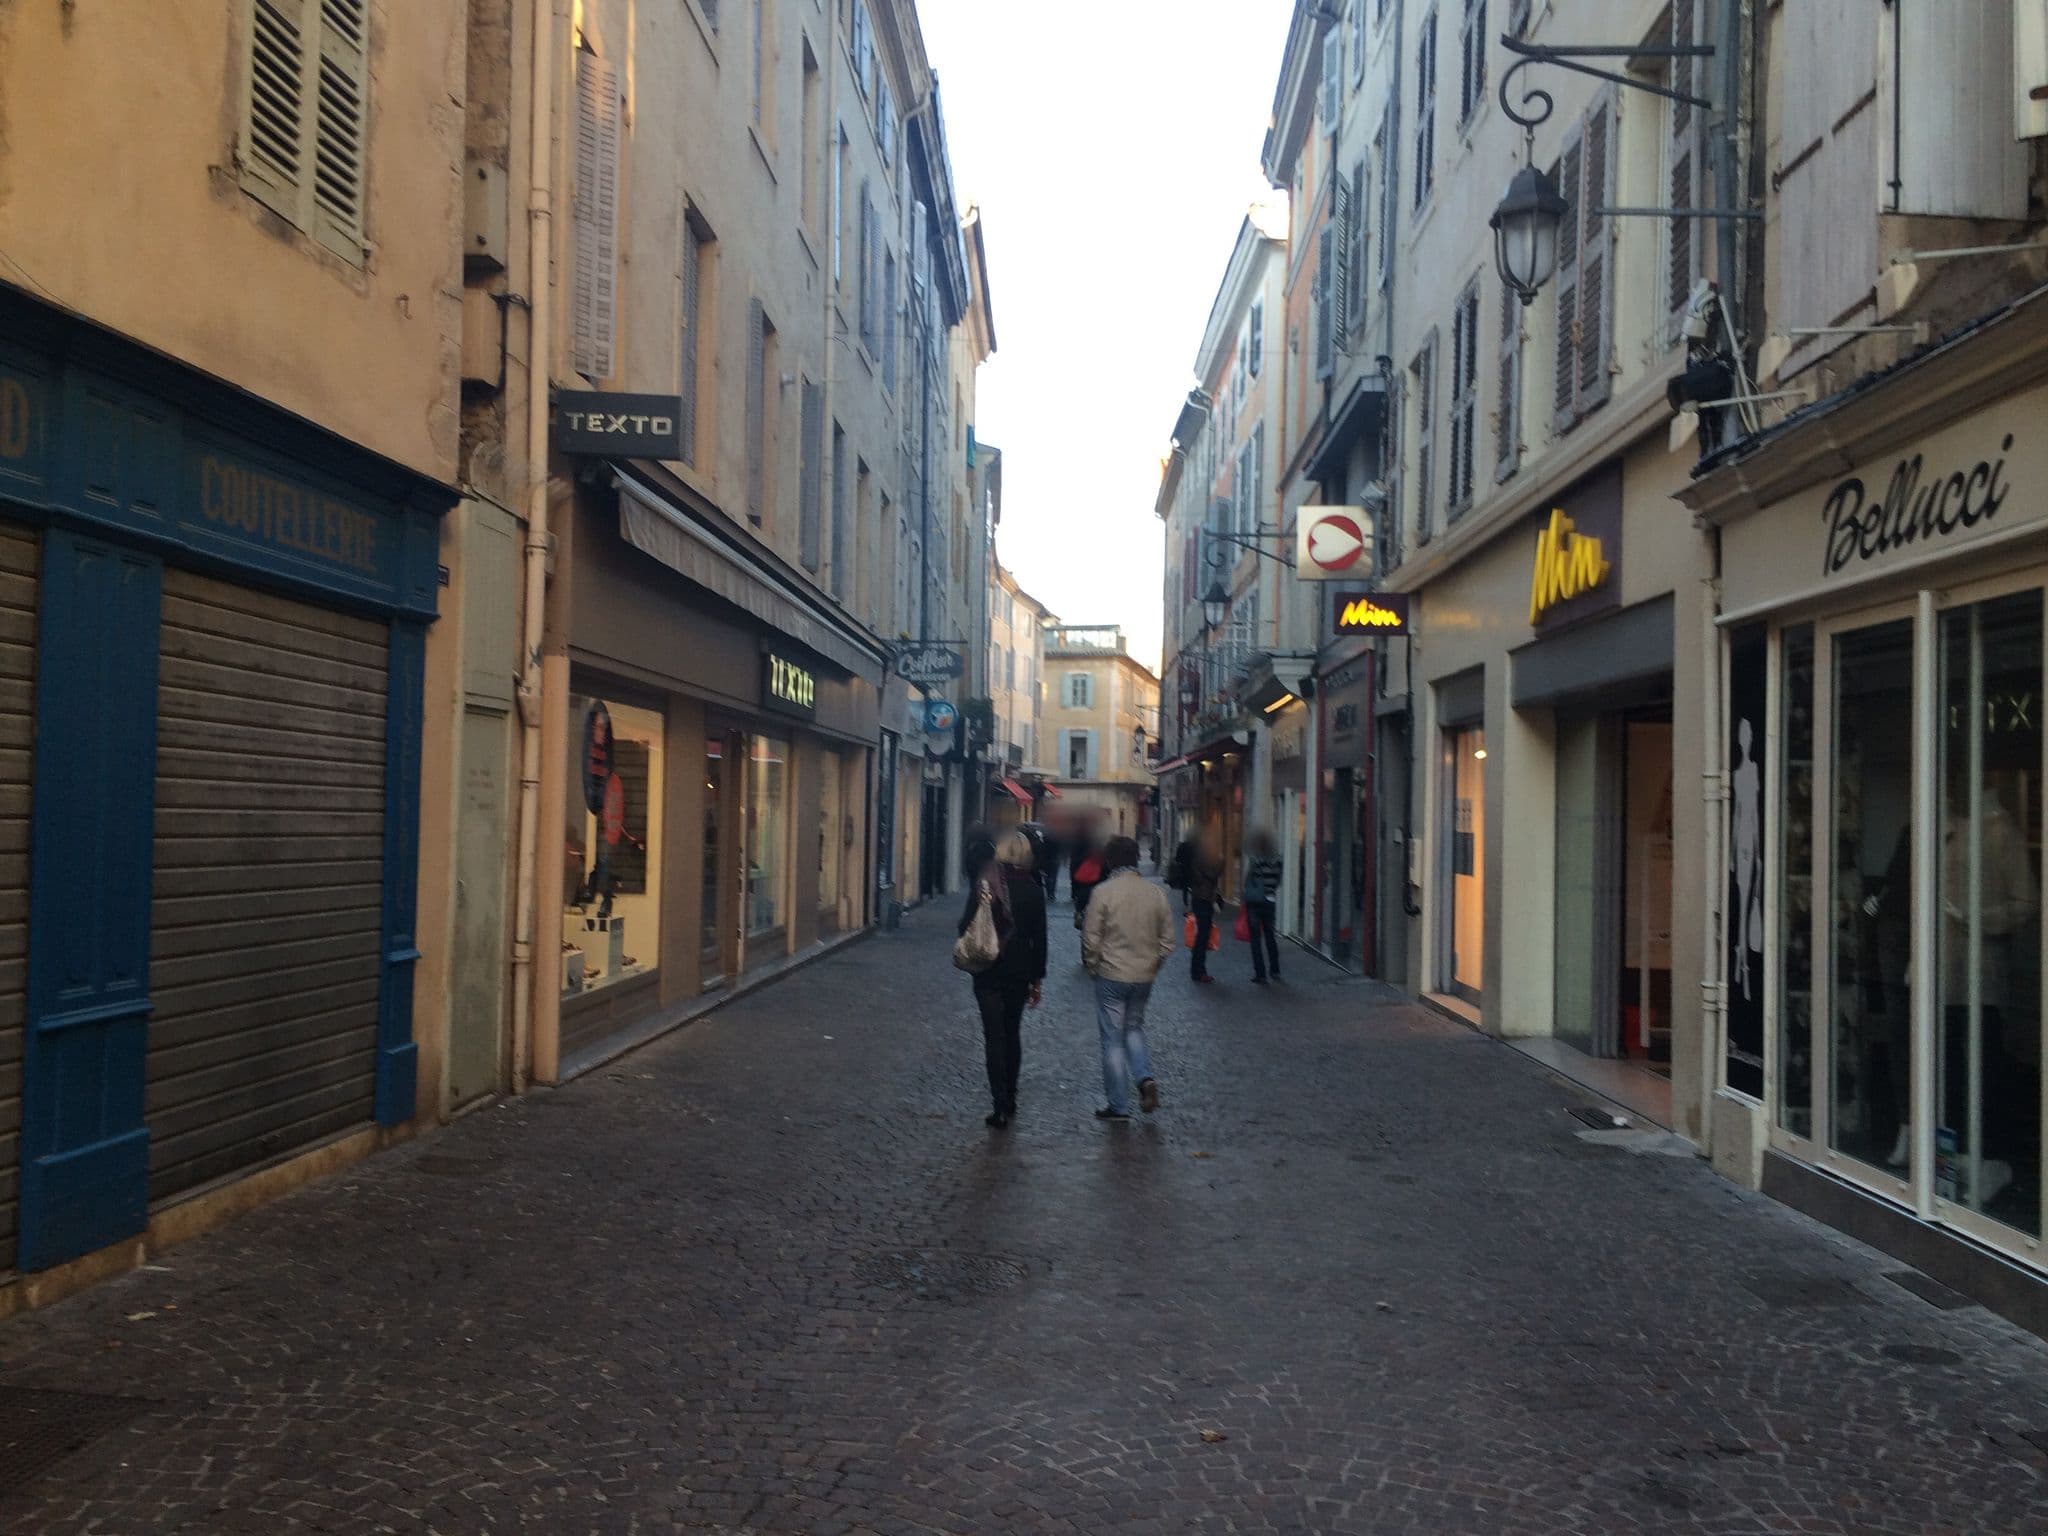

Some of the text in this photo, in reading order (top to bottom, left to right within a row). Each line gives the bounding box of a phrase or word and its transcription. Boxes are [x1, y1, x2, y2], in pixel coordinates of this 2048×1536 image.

[565, 413, 673, 436] TEXTO
[201, 458, 377, 572] COUTELLERIE
[1823, 433, 2013, 576] Bellucci
[1530, 509, 1609, 625] Mim
[1340, 600, 1401, 626] Mim
[770, 654, 815, 710] TEXTO
